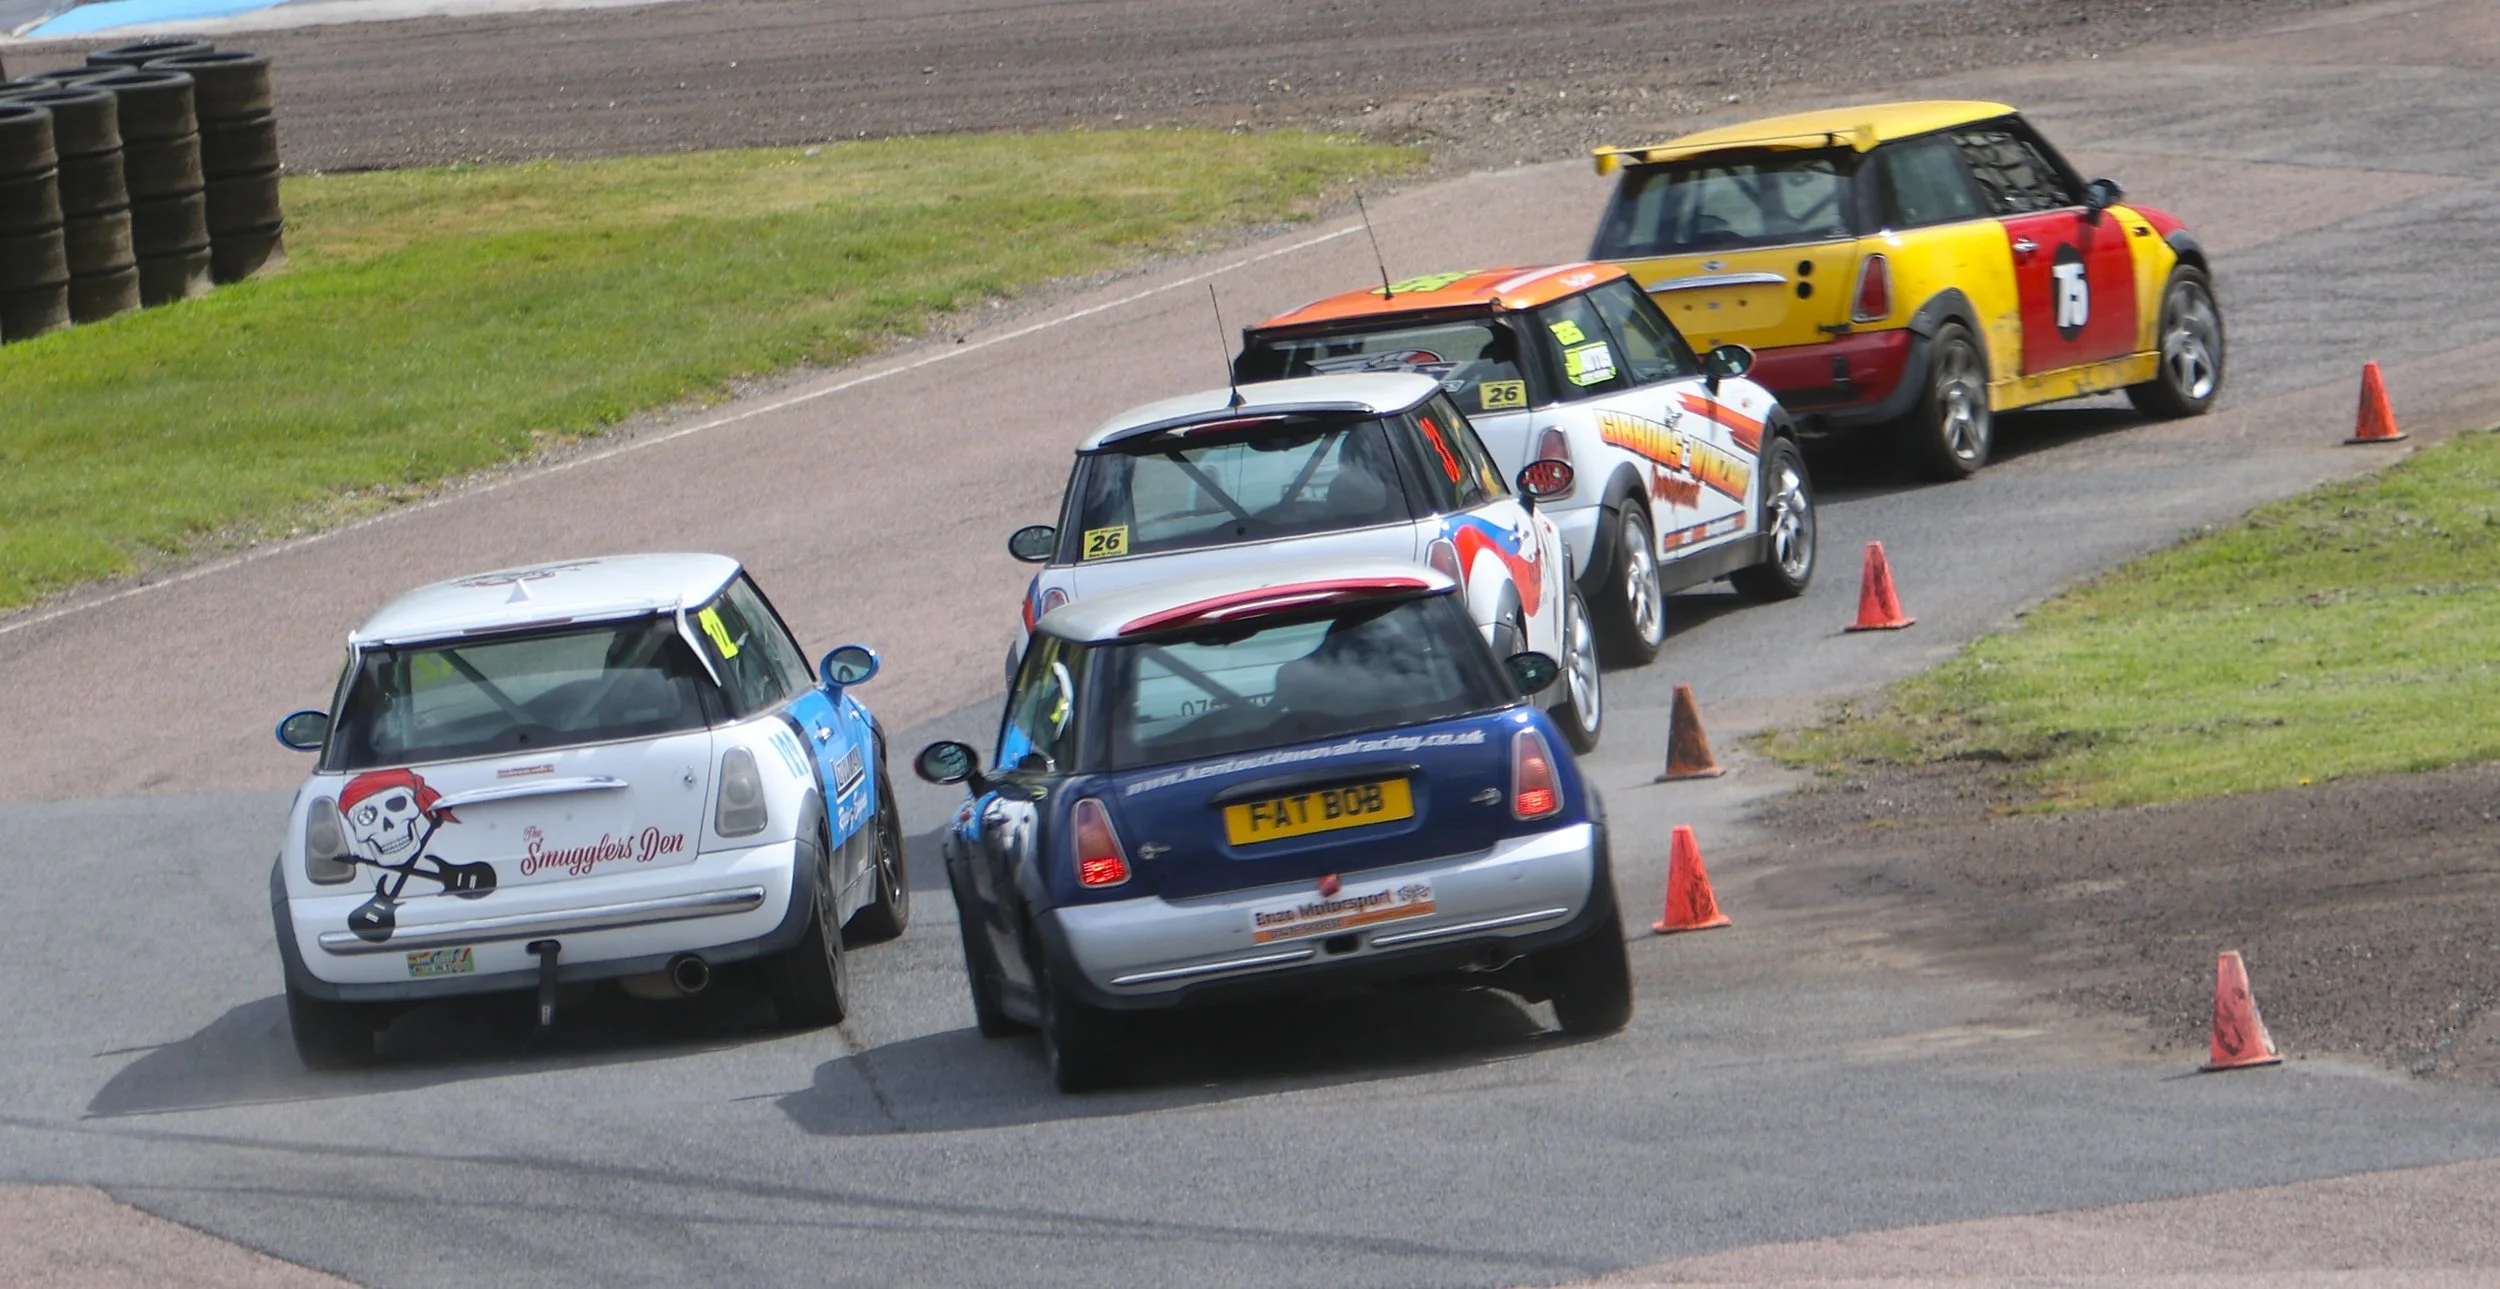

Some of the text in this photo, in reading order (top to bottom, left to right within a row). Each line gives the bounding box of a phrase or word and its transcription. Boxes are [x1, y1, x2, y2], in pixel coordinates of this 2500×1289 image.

[1488, 387, 1519, 403] 26
[1594, 409, 1683, 472] GIBBONS
[1089, 532, 1121, 553] 26
[1250, 785, 1384, 832] FAT BOB
[523, 825, 543, 842] The
[636, 826, 684, 863] Den
[1298, 888, 1394, 918] Motorsport
